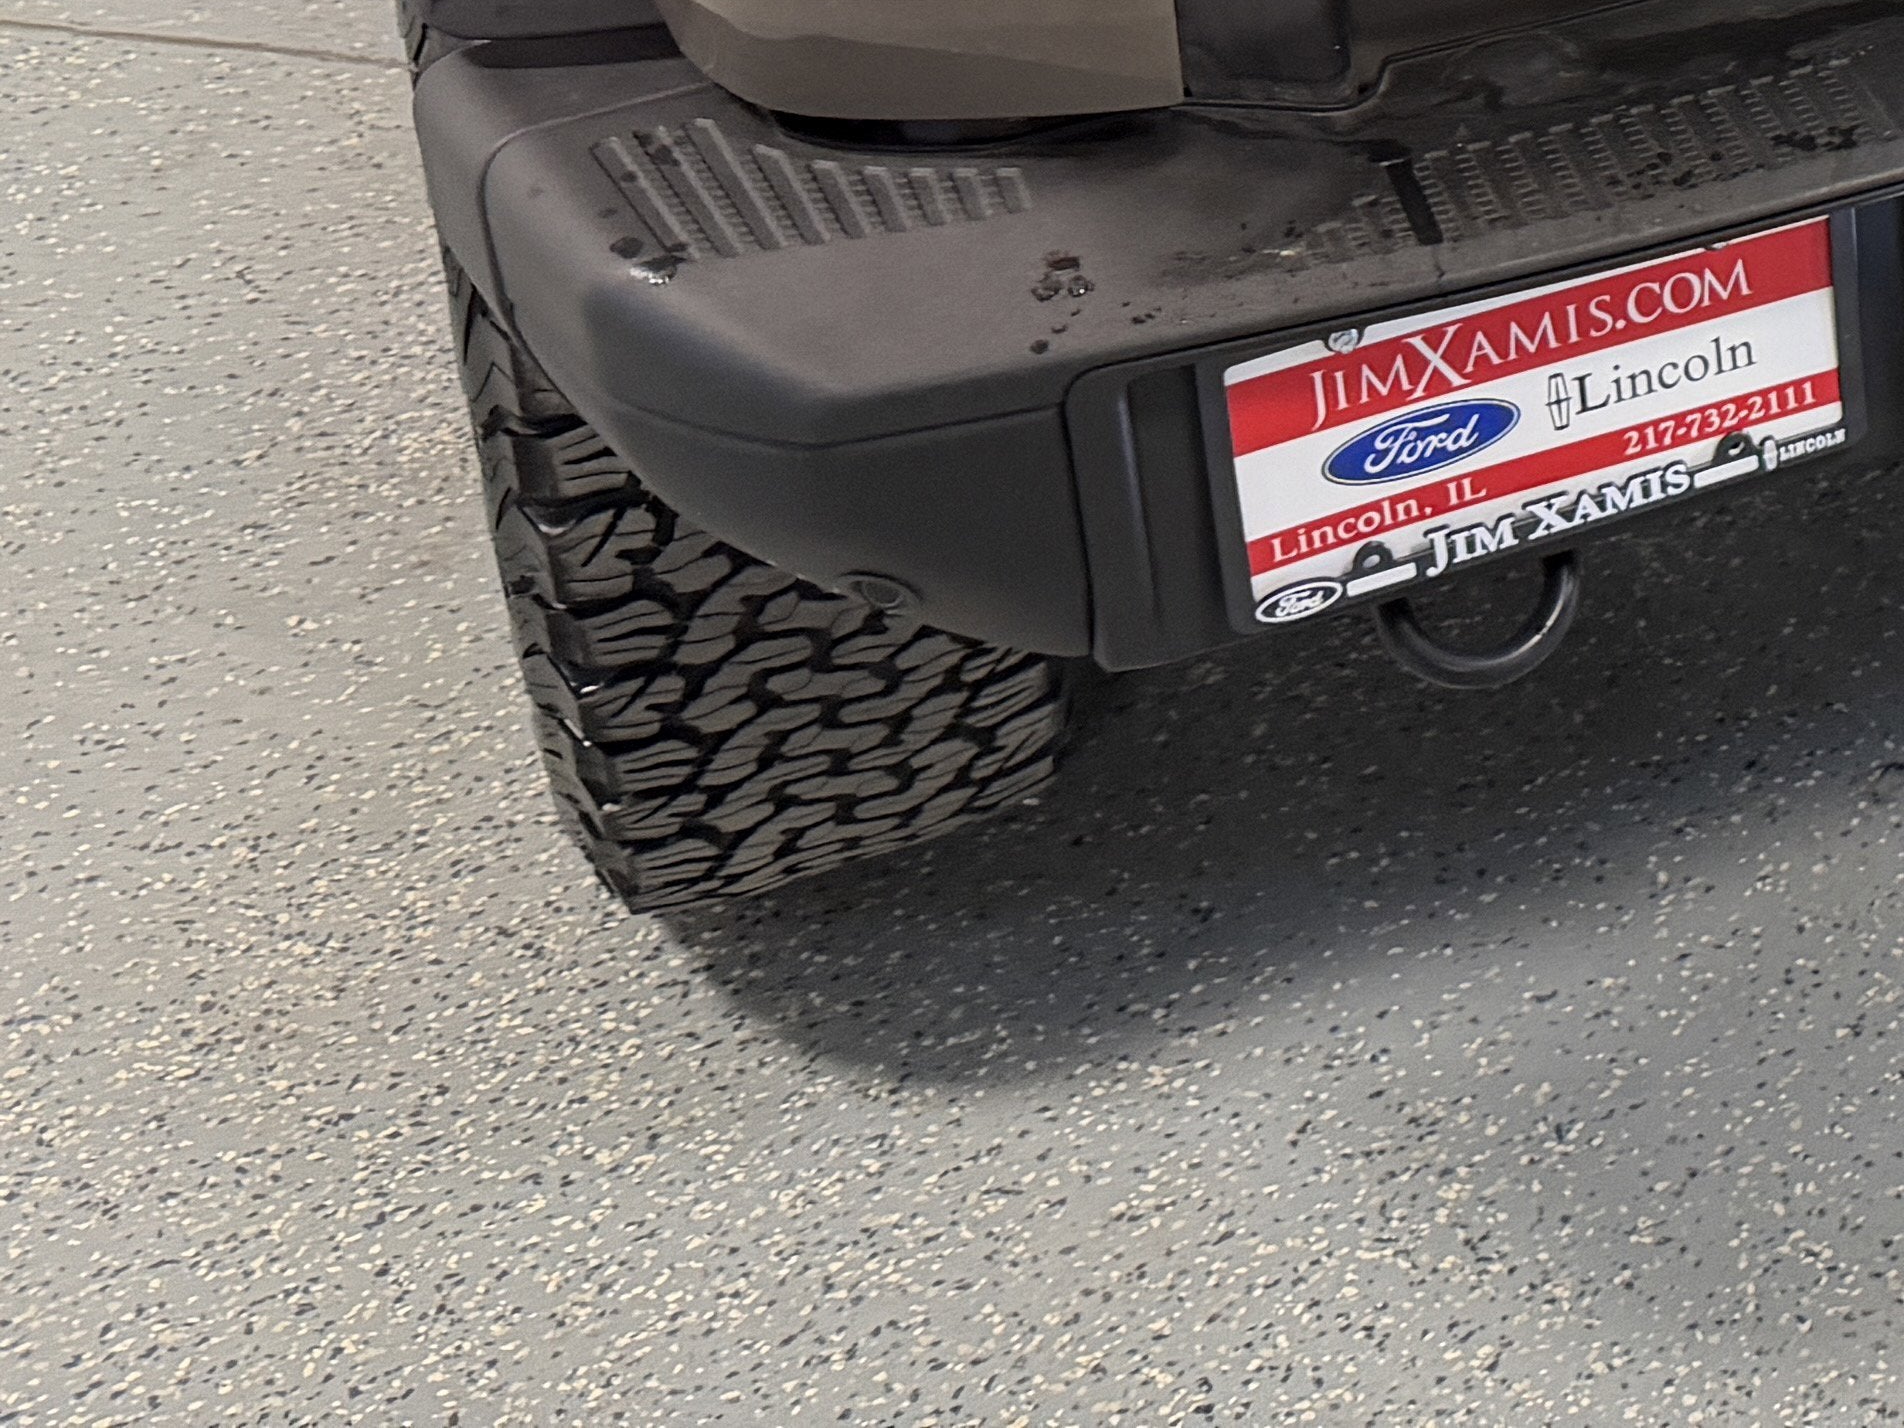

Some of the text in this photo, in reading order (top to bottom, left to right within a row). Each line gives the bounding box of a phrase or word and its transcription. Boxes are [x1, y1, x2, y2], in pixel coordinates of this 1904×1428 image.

[1308, 258, 1752, 431] JIMXAMIS.COM
[1571, 336, 1758, 415] Lincoln
[1364, 413, 1479, 474] Ford
[1623, 380, 1817, 456] 217-732-2111
[1779, 428, 1847, 461] LINCOLN
[1272, 477, 1487, 563] Lincoln, IL
[1426, 463, 1692, 578] JIM XAMIS
